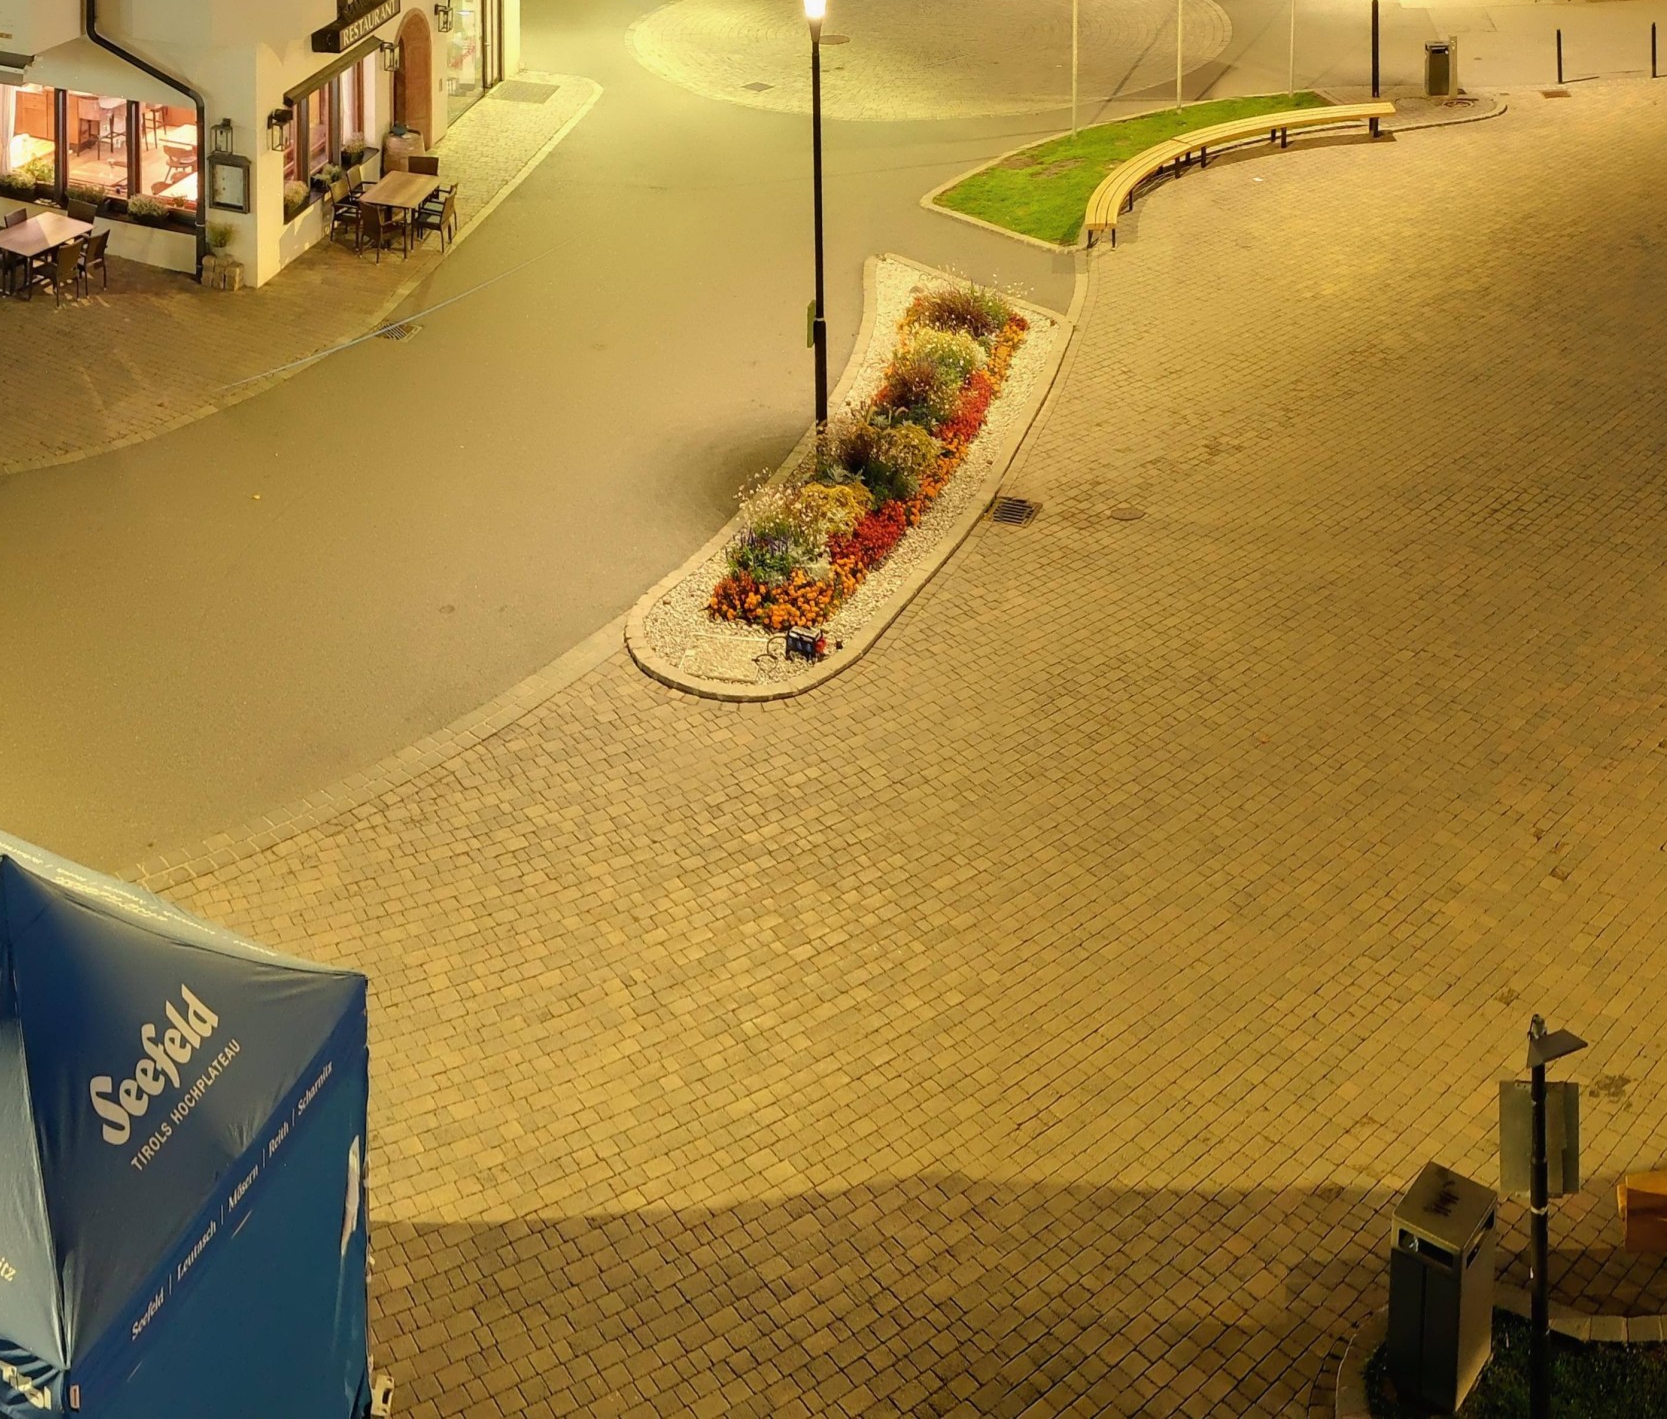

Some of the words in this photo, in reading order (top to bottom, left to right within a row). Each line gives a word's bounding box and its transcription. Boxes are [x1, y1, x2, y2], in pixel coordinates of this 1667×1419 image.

[90, 983, 219, 1146] Seefeld
[130, 1122, 172, 1172] TIROLS
[171, 1038, 240, 1125] HOCHPLATEAU
[132, 1287, 165, 1341] Seefeld
[176, 1220, 217, 1281] Leutasch
[227, 1164, 259, 1213] Mösern
[268, 1121, 290, 1158] Reith
[298, 1061, 333, 1116] Scharnitz
